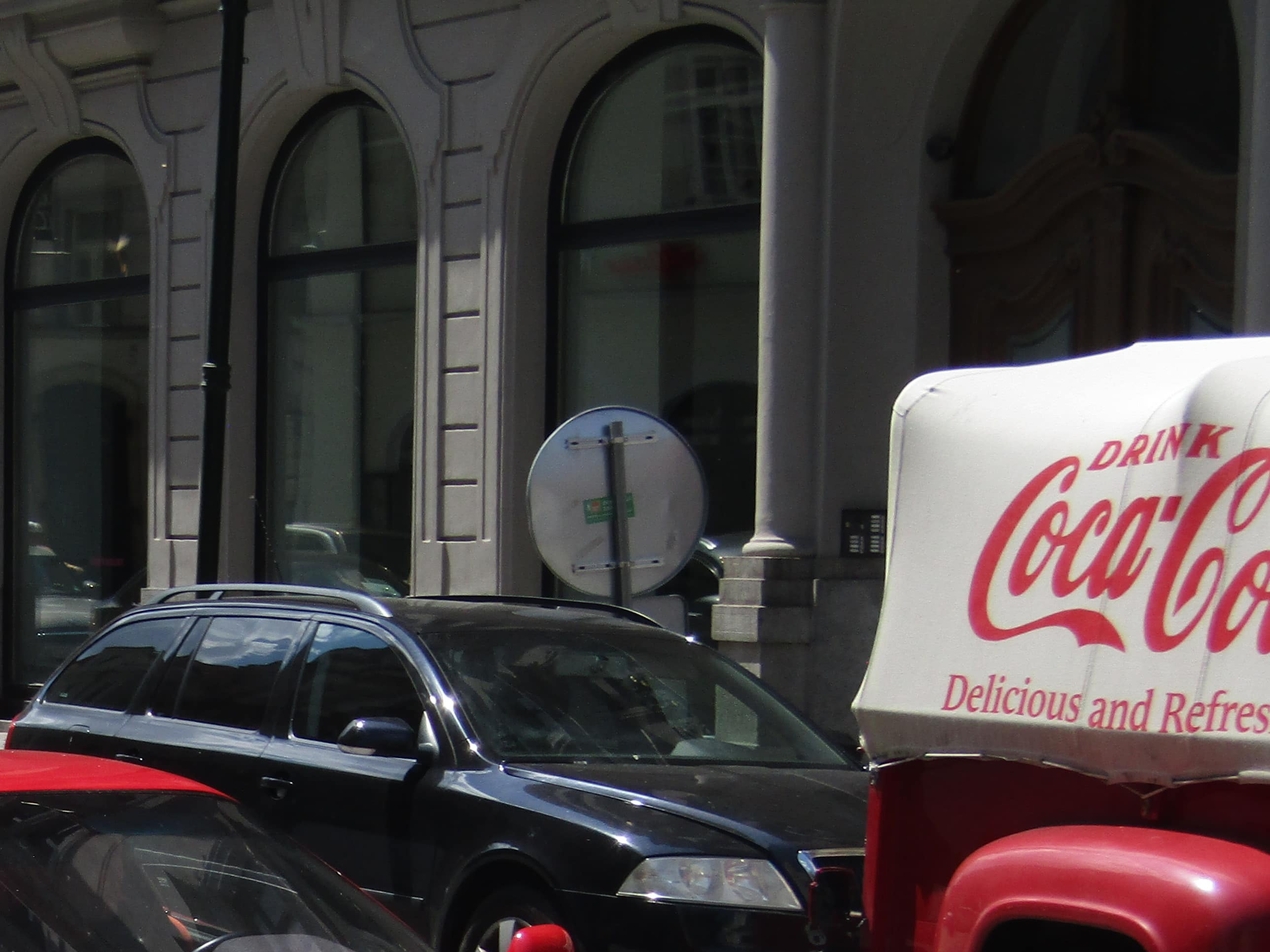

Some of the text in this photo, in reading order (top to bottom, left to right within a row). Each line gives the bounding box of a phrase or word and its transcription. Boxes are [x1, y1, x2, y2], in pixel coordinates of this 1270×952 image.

[1086, 423, 1234, 471] DRINK
[941, 673, 1270, 734] Delicious and Refres
